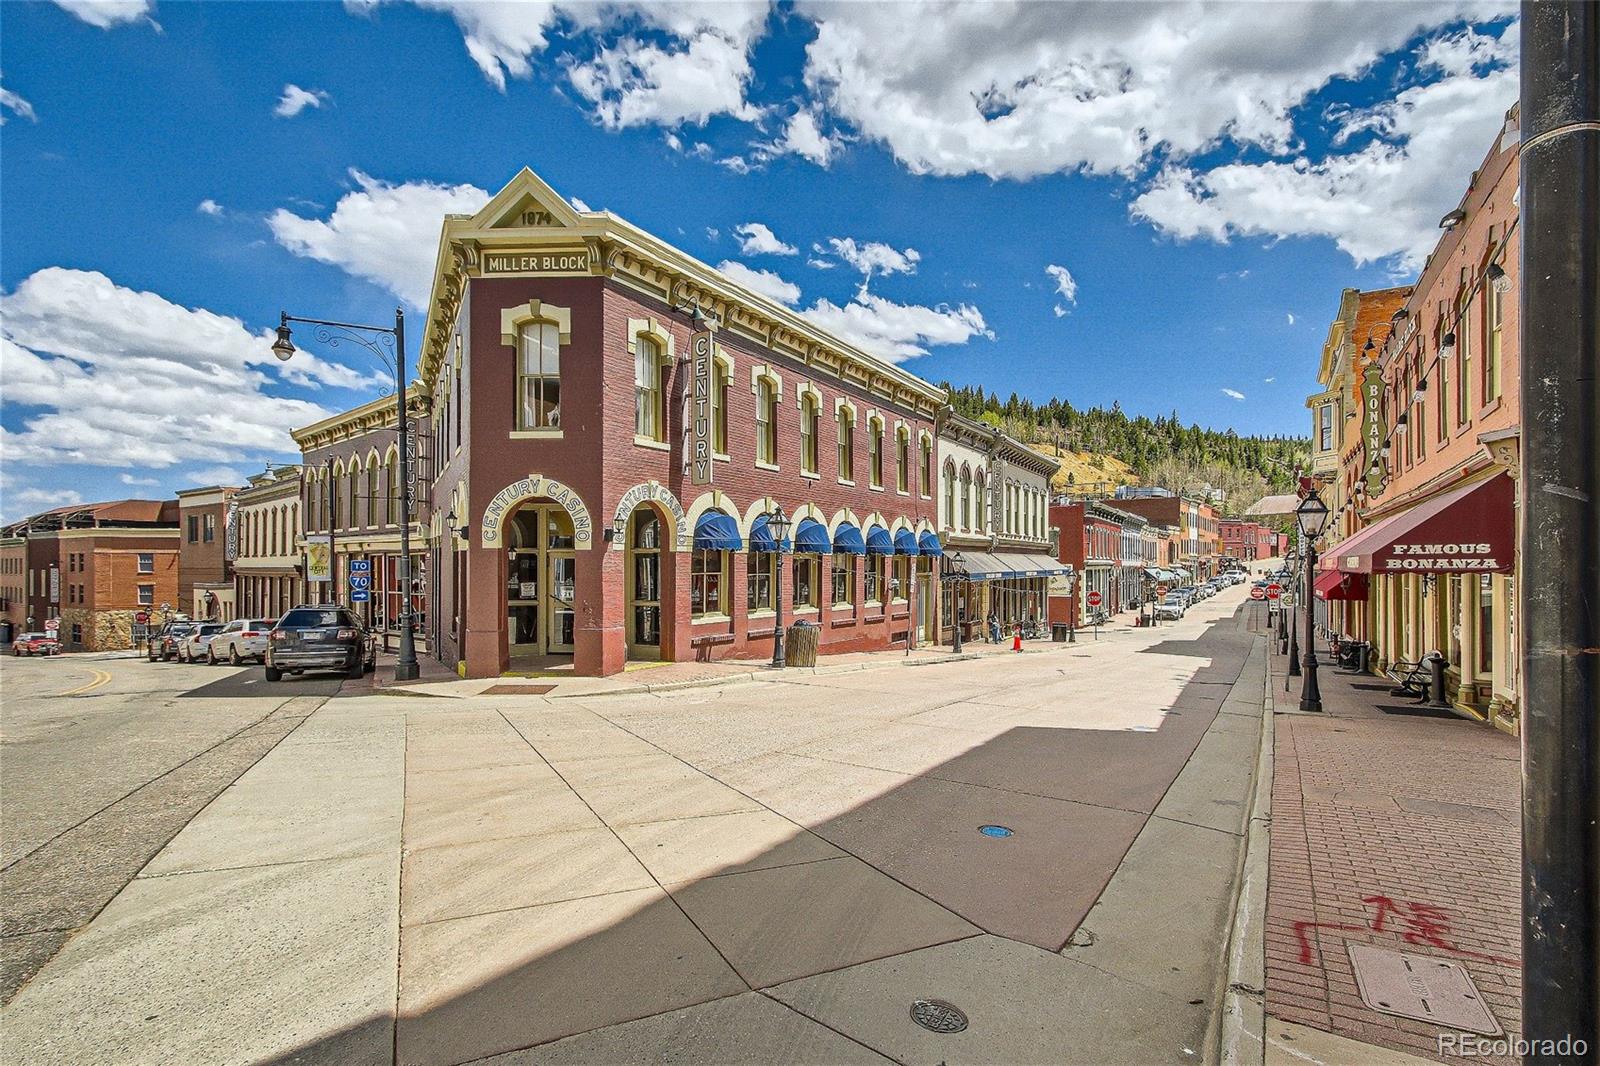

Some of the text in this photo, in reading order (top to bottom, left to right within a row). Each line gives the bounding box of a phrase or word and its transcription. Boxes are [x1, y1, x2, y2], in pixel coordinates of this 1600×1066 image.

[521, 211, 552, 225] 1874
[488, 256, 586, 271] MILLER BLOCK
[695, 337, 709, 480] CENTURY
[1368, 384, 1380, 463] BONANZ
[405, 420, 416, 511] CENTURY
[483, 479, 591, 542] CENTURY CASINO
[614, 485, 659, 543] CNTURY
[1393, 543, 1492, 555] FAMOUS
[353, 562, 368, 570] TO
[1385, 558, 1500, 569] BONANZA
[352, 577, 368, 586] 70
